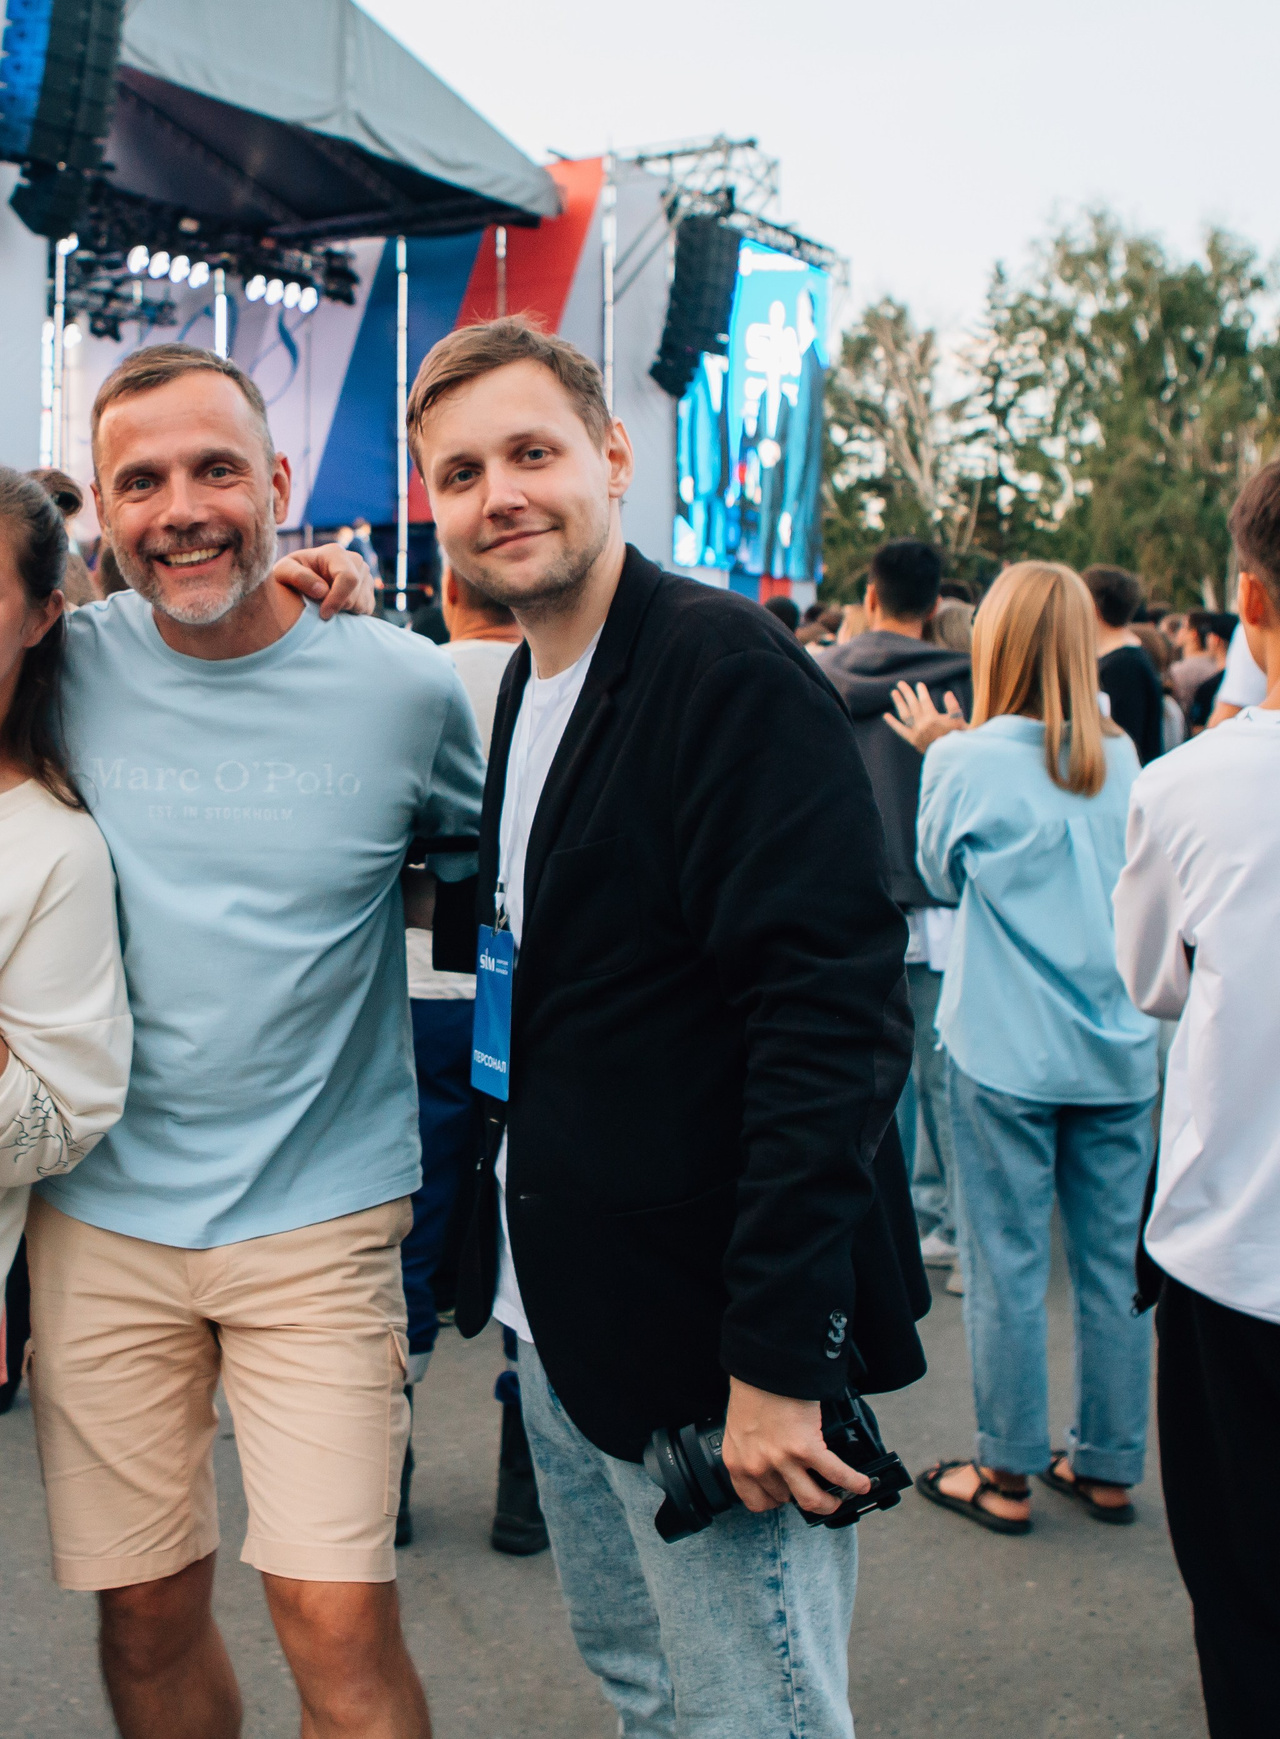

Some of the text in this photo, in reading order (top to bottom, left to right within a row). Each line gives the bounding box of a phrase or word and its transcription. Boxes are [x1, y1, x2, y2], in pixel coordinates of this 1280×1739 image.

[90, 757, 362, 797] Marc O'Polo
[148, 804, 294, 822] EST. IN STOCKHOLM
[473, 1049, 507, 1074] ПЕРСОНАЛ
